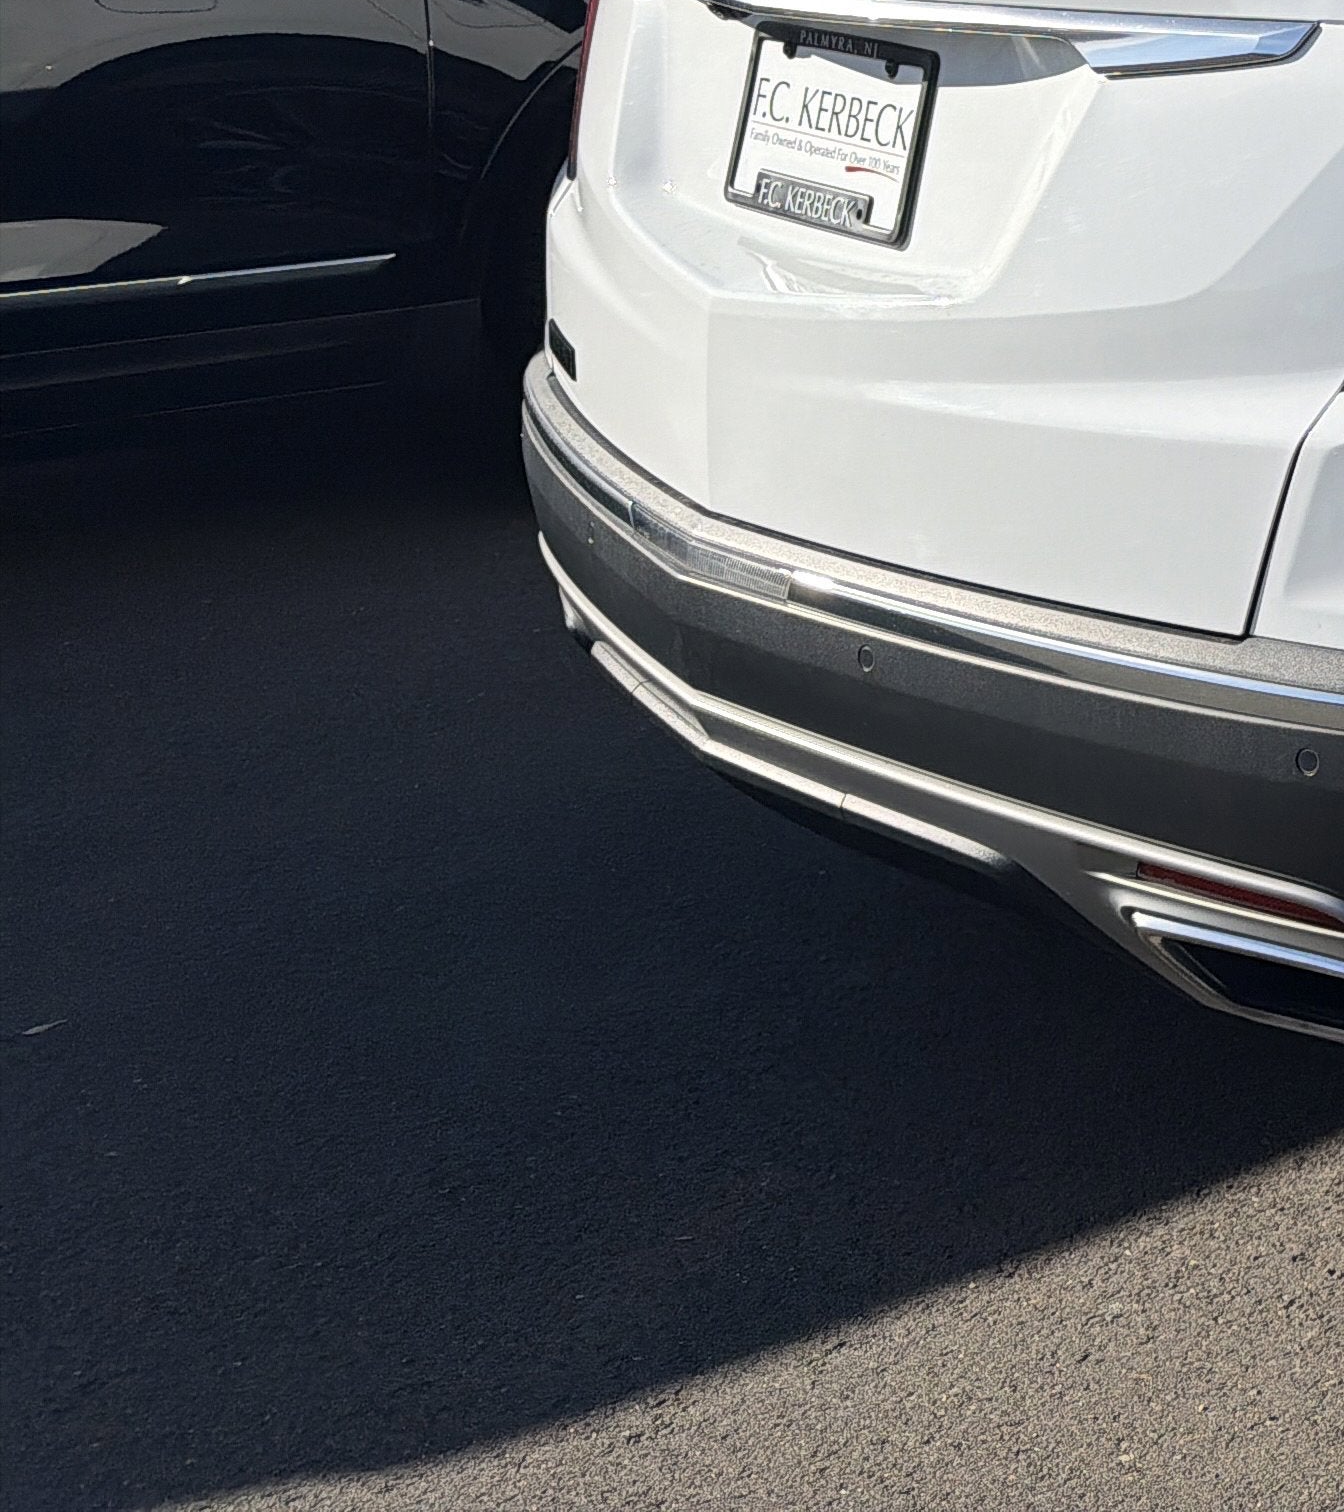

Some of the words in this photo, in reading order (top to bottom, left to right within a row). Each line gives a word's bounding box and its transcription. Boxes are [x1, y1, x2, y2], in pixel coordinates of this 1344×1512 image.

[800, 31, 858, 54] PALMYRA,
[753, 77, 790, 123] F.C.
[797, 86, 915, 151] KERBECK
[750, 127, 770, 144] Family
[771, 132, 797, 149] Owned
[804, 140, 836, 160] Operated
[836, 148, 848, 162] For
[849, 151, 867, 165] Over
[868, 156, 881, 169] 100
[883, 159, 901, 175] Years
[757, 178, 782, 208] F.C.
[784, 185, 856, 228] KERBECK
